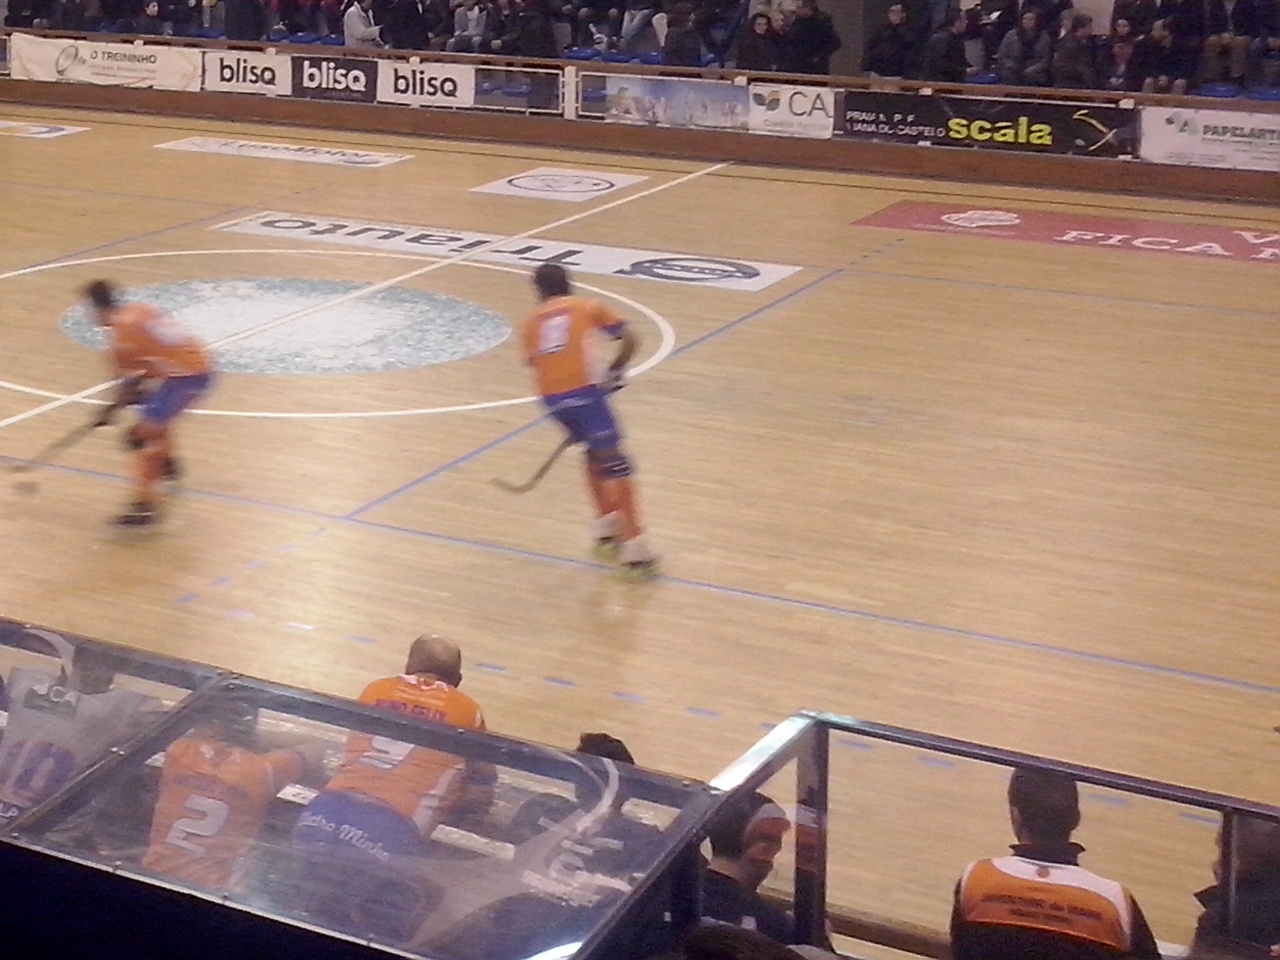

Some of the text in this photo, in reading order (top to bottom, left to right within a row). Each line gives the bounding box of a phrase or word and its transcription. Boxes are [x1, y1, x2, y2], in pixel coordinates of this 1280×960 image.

[788, 91, 830, 118] CA
[947, 116, 1053, 146] scala
[1054, 230, 1232, 256] FICA
[166, 794, 230, 856] 2
